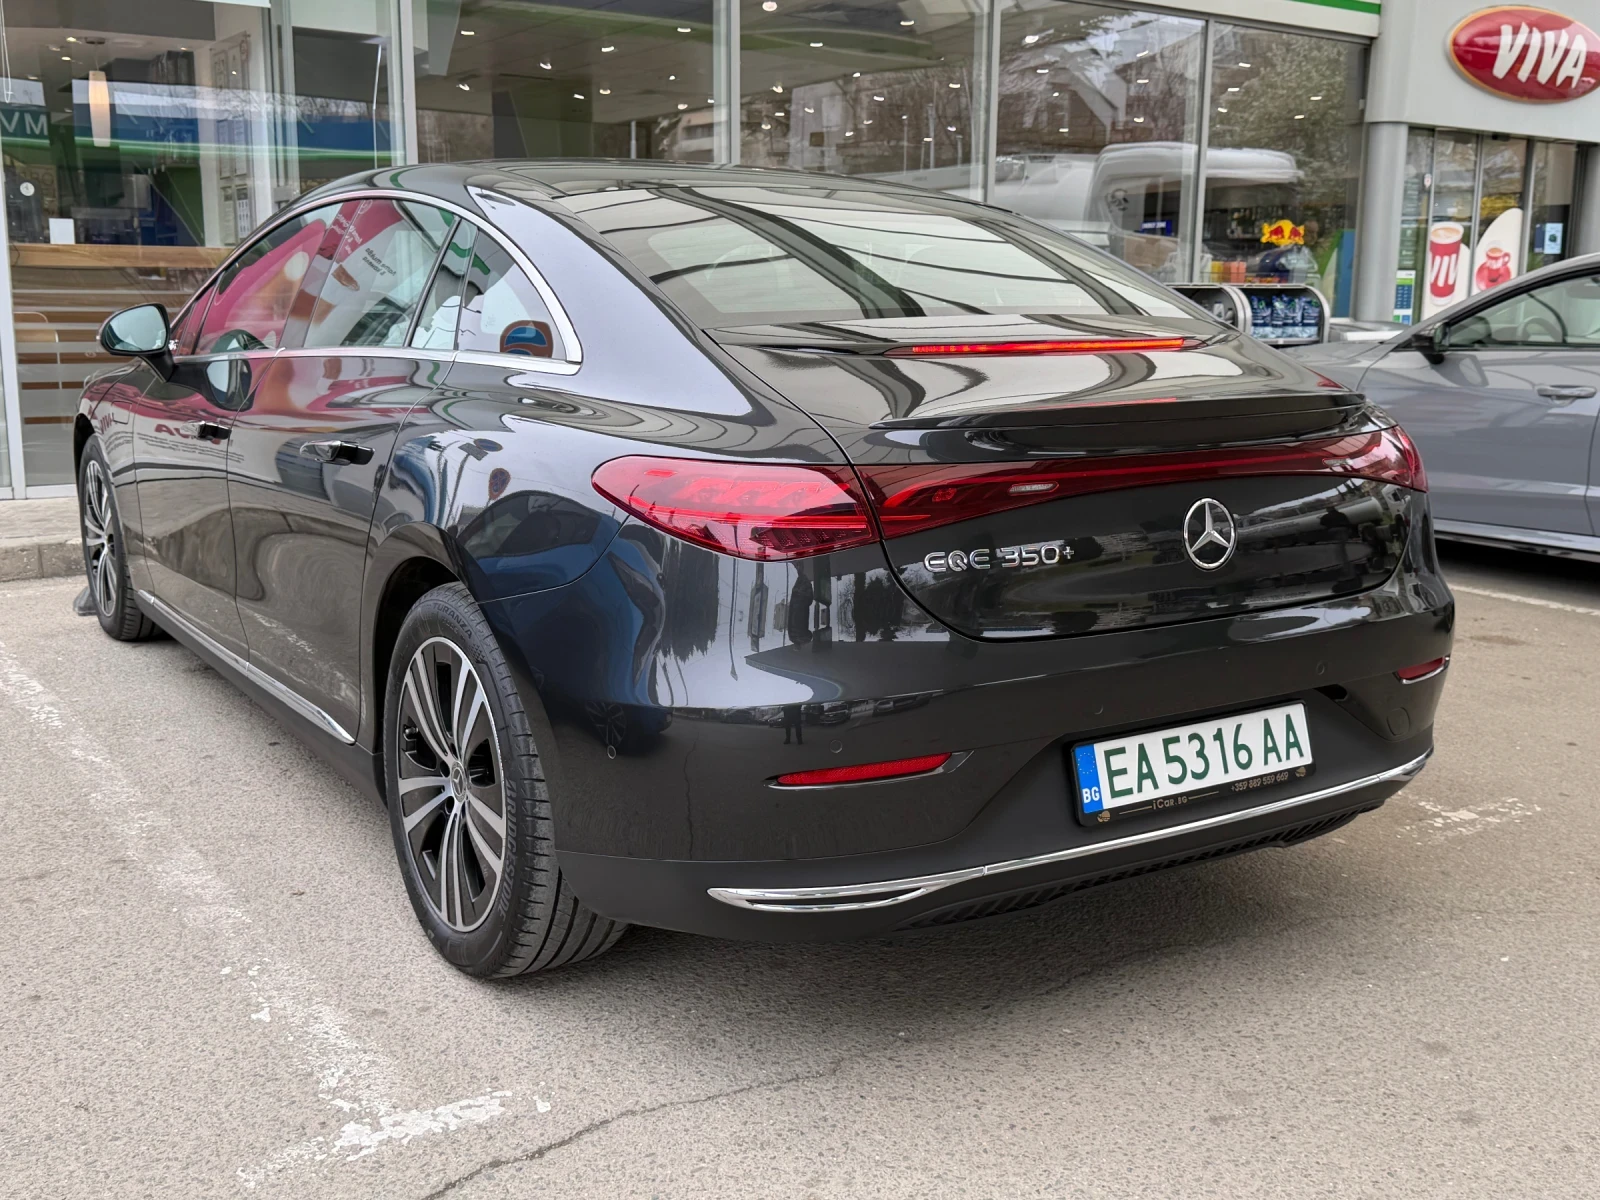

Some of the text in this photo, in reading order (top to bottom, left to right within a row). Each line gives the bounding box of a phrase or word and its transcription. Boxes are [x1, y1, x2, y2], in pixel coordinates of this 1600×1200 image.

[1492, 21, 1587, 89] VIVA
[923, 543, 1075, 573] EQE 350+
[432, 602, 473, 639] TURANZA
[1103, 713, 1304, 799] EA 5316 AA
[1082, 787, 1100, 804] BG
[1230, 782, 1247, 793] +359
[1262, 775, 1276, 786] 559
[1276, 771, 1289, 782] 669
[498, 778, 517, 921] BRIDGESTONE
